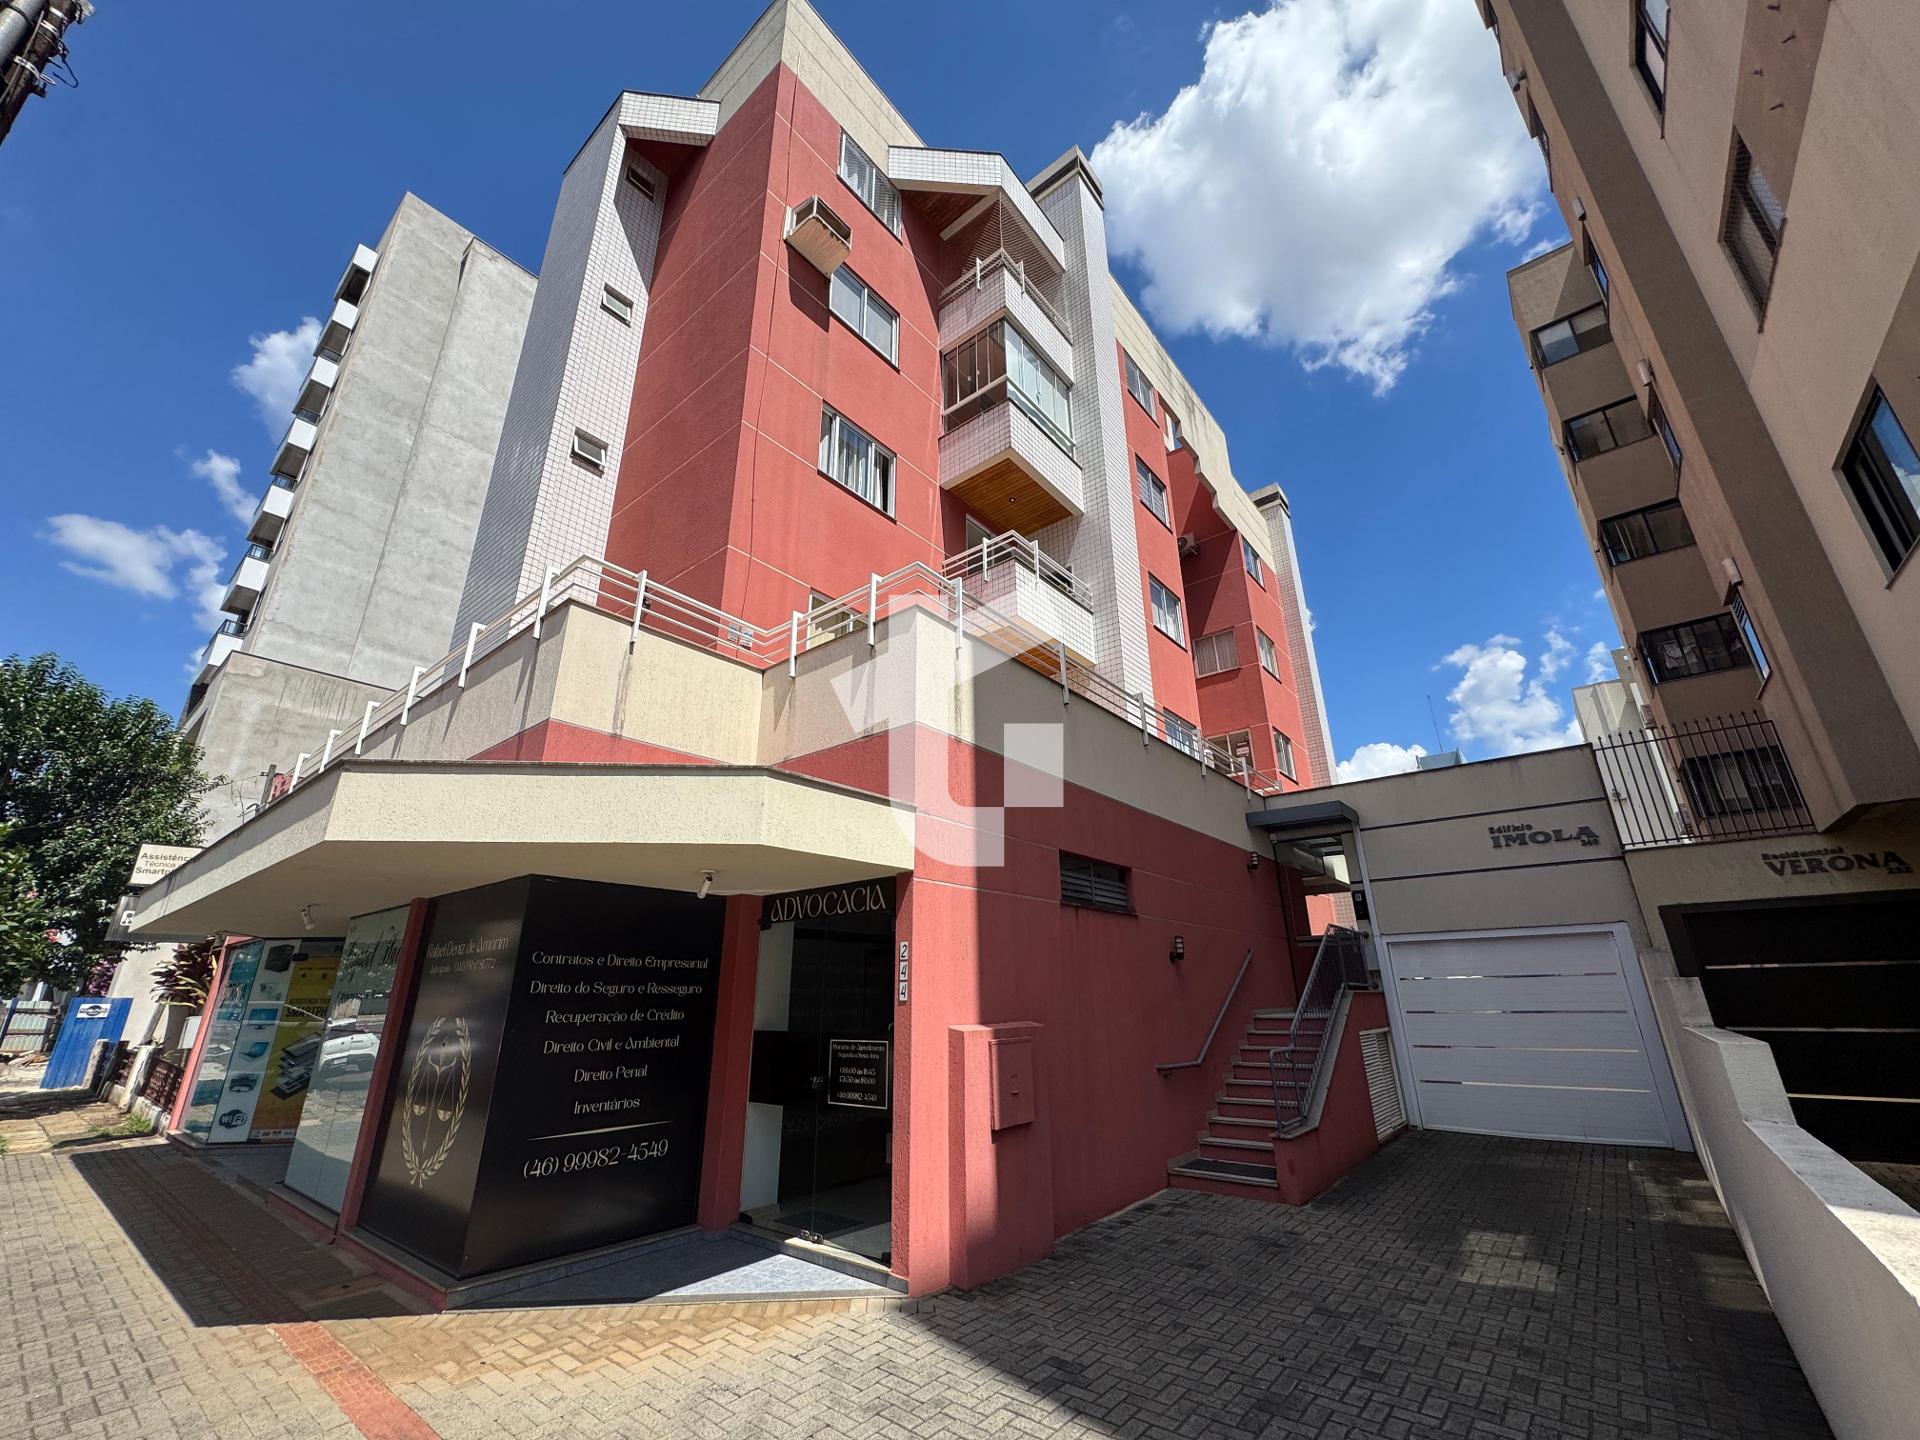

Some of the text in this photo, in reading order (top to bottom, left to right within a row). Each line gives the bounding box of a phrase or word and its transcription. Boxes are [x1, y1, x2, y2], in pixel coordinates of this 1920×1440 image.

[1490, 826, 1600, 848] IMOLA
[144, 860, 176, 868] Técnica
[1764, 851, 1911, 876] VERONA
[770, 884, 886, 922] ADVOCACIA
[532, 950, 709, 971] Contratos e Direito Empresarial
[900, 943, 908, 1000] 244
[529, 980, 703, 998] Direito do Seguro e Resseguro
[545, 1008, 685, 1026] Recuperação de Crédito
[543, 1034, 680, 1054] Direito Civil e Ambiental
[573, 1063, 648, 1083] Direito Penal
[573, 1097, 641, 1115] Inventários
[523, 1138, 669, 1178] (46) 99982-4549
